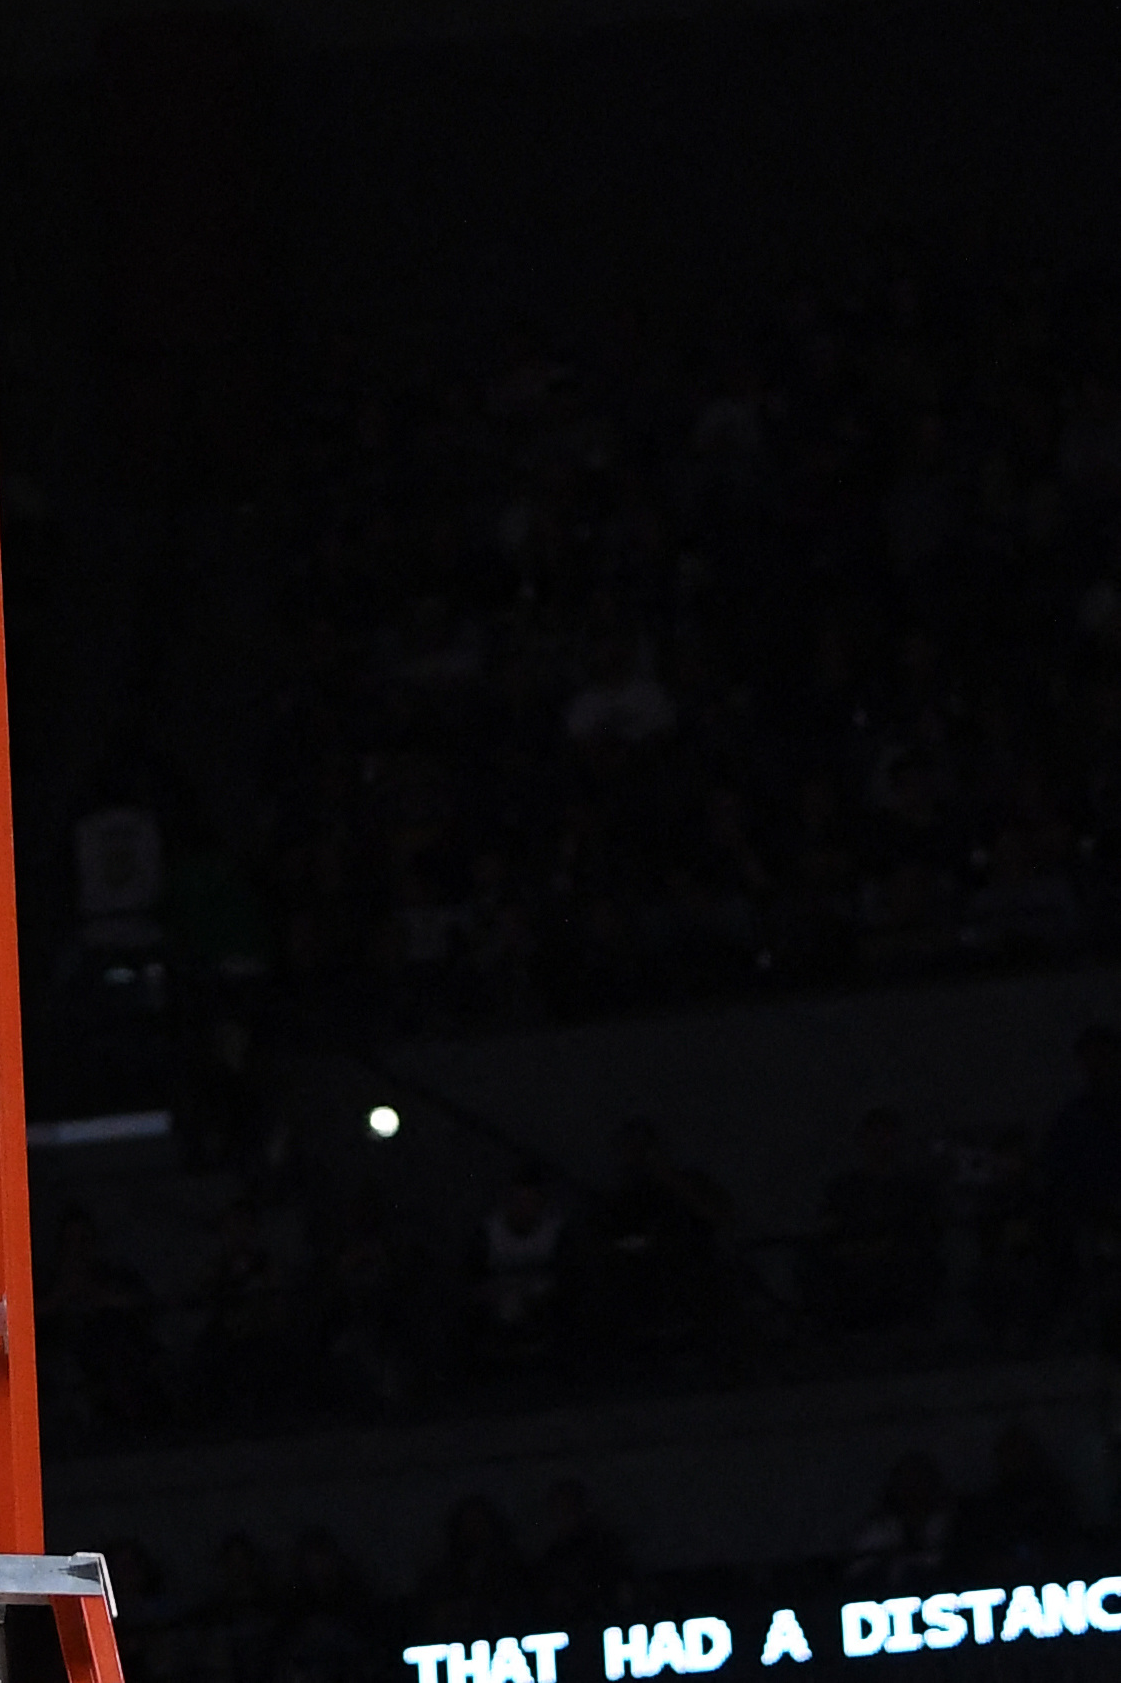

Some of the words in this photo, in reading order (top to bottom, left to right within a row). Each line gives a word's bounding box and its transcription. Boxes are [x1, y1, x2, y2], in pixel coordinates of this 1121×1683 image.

[403, 1632, 569, 1683] THAT
[603, 1617, 732, 1680] HAD
[761, 1609, 812, 1664] A
[841, 1576, 1121, 1656] DISTANC
